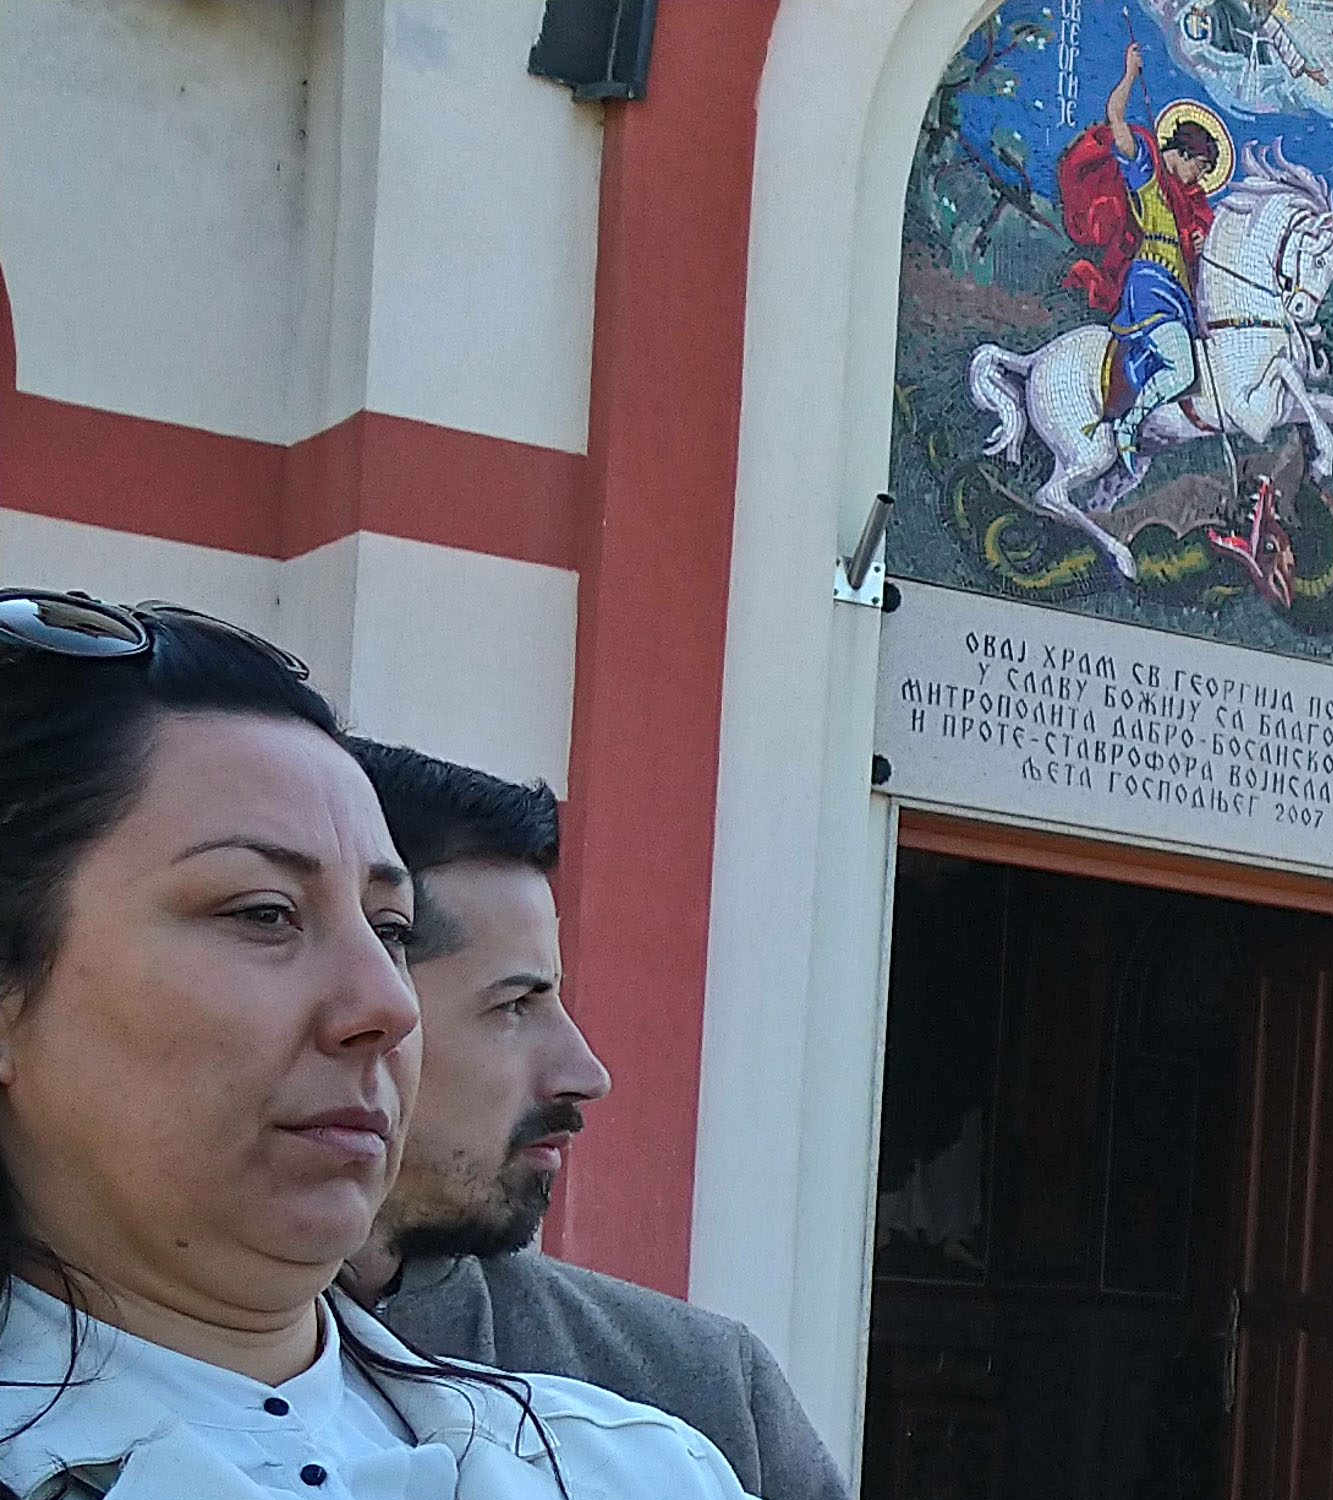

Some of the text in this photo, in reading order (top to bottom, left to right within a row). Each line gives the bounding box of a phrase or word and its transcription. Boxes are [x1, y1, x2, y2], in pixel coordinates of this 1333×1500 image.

[965, 631, 1026, 663] ОВАЈ
[1043, 645, 1116, 681] ХРАМ
[1175, 669, 1294, 713] ГЕОРГИЈА
[978, 661, 991, 686] У
[1007, 667, 1089, 702] СЛАВУ
[1104, 684, 1201, 724] БОЖИЈУ
[1216, 706, 1244, 732] СА
[901, 678, 1096, 733] МИТРОПОЛИТА
[1275, 802, 1323, 828] 2007
